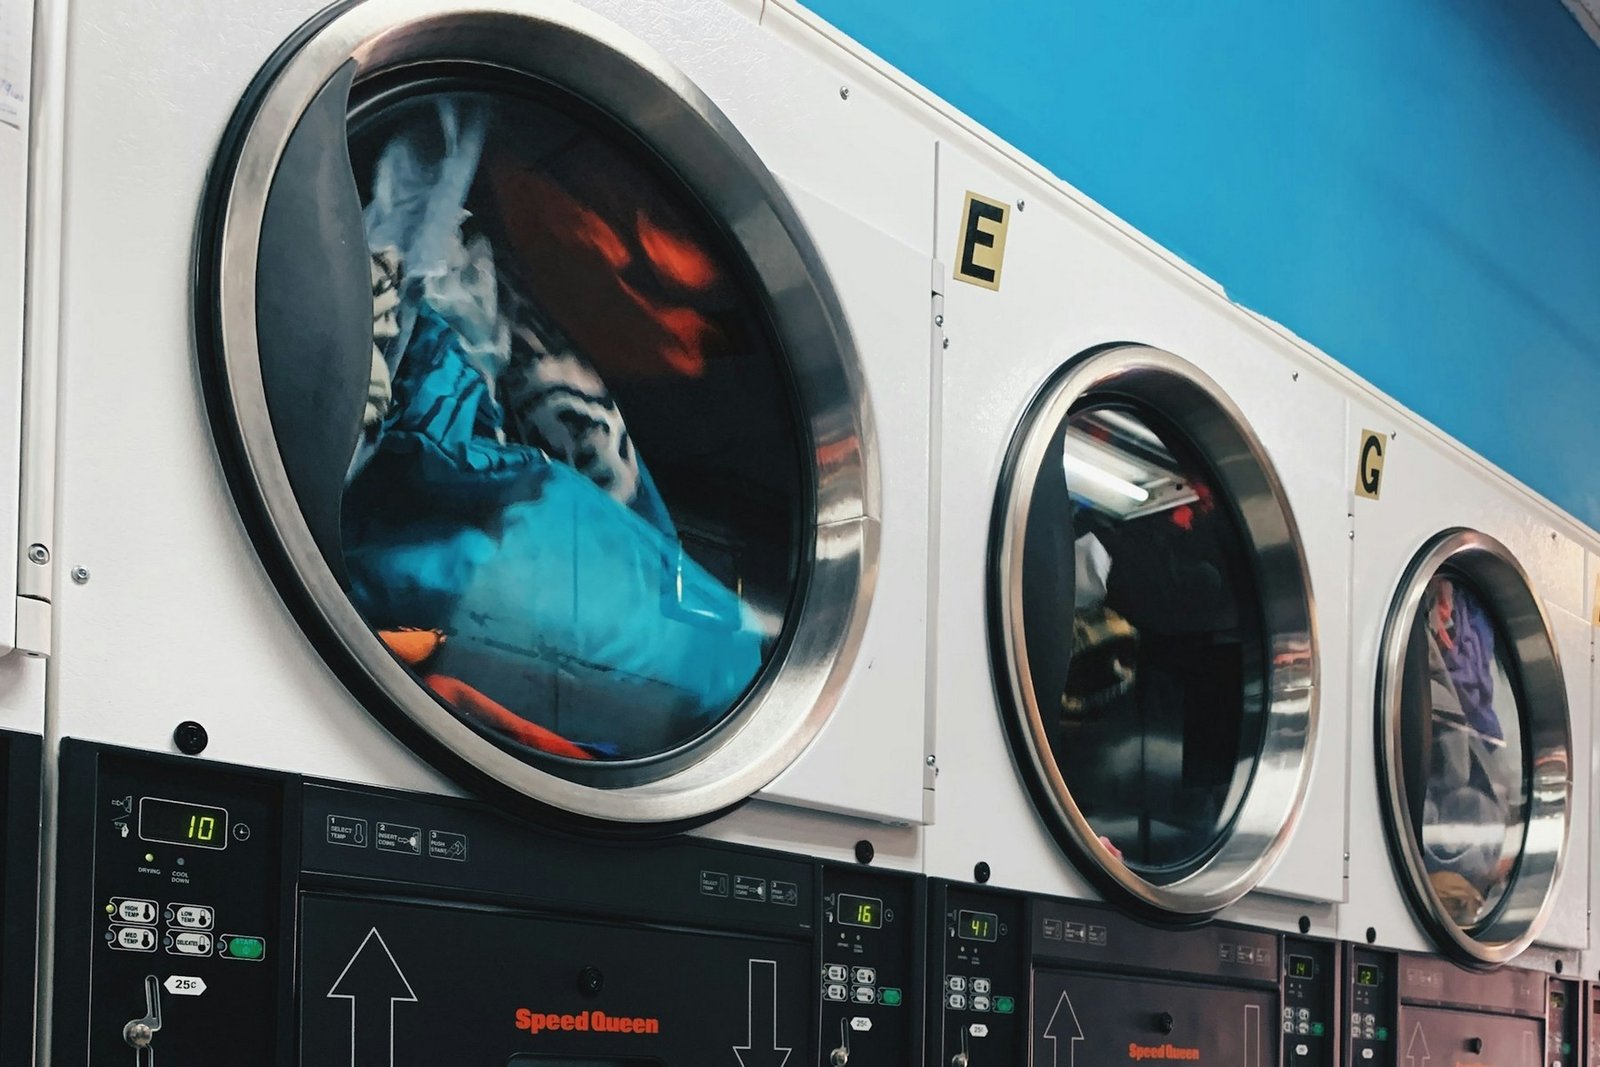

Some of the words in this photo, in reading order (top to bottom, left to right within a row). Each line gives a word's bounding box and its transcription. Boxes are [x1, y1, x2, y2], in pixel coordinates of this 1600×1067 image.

[960, 198, 1004, 283] E
[1361, 435, 1382, 495] G
[188, 815, 214, 840] 10
[330, 825, 352, 834] SELECT
[378, 832, 397, 841] INSERT
[378, 839, 395, 847] COINS
[138, 867, 161, 875] DRYING
[172, 870, 189, 878] COOL
[857, 905, 872, 923] 16
[970, 920, 988, 937] 41
[176, 939, 199, 947] DELICATES
[515, 1008, 589, 1034] Speed
[591, 1011, 659, 1034] Queen
[1129, 1043, 1165, 1061] Speed
[1166, 1044, 1199, 1060] Queen
